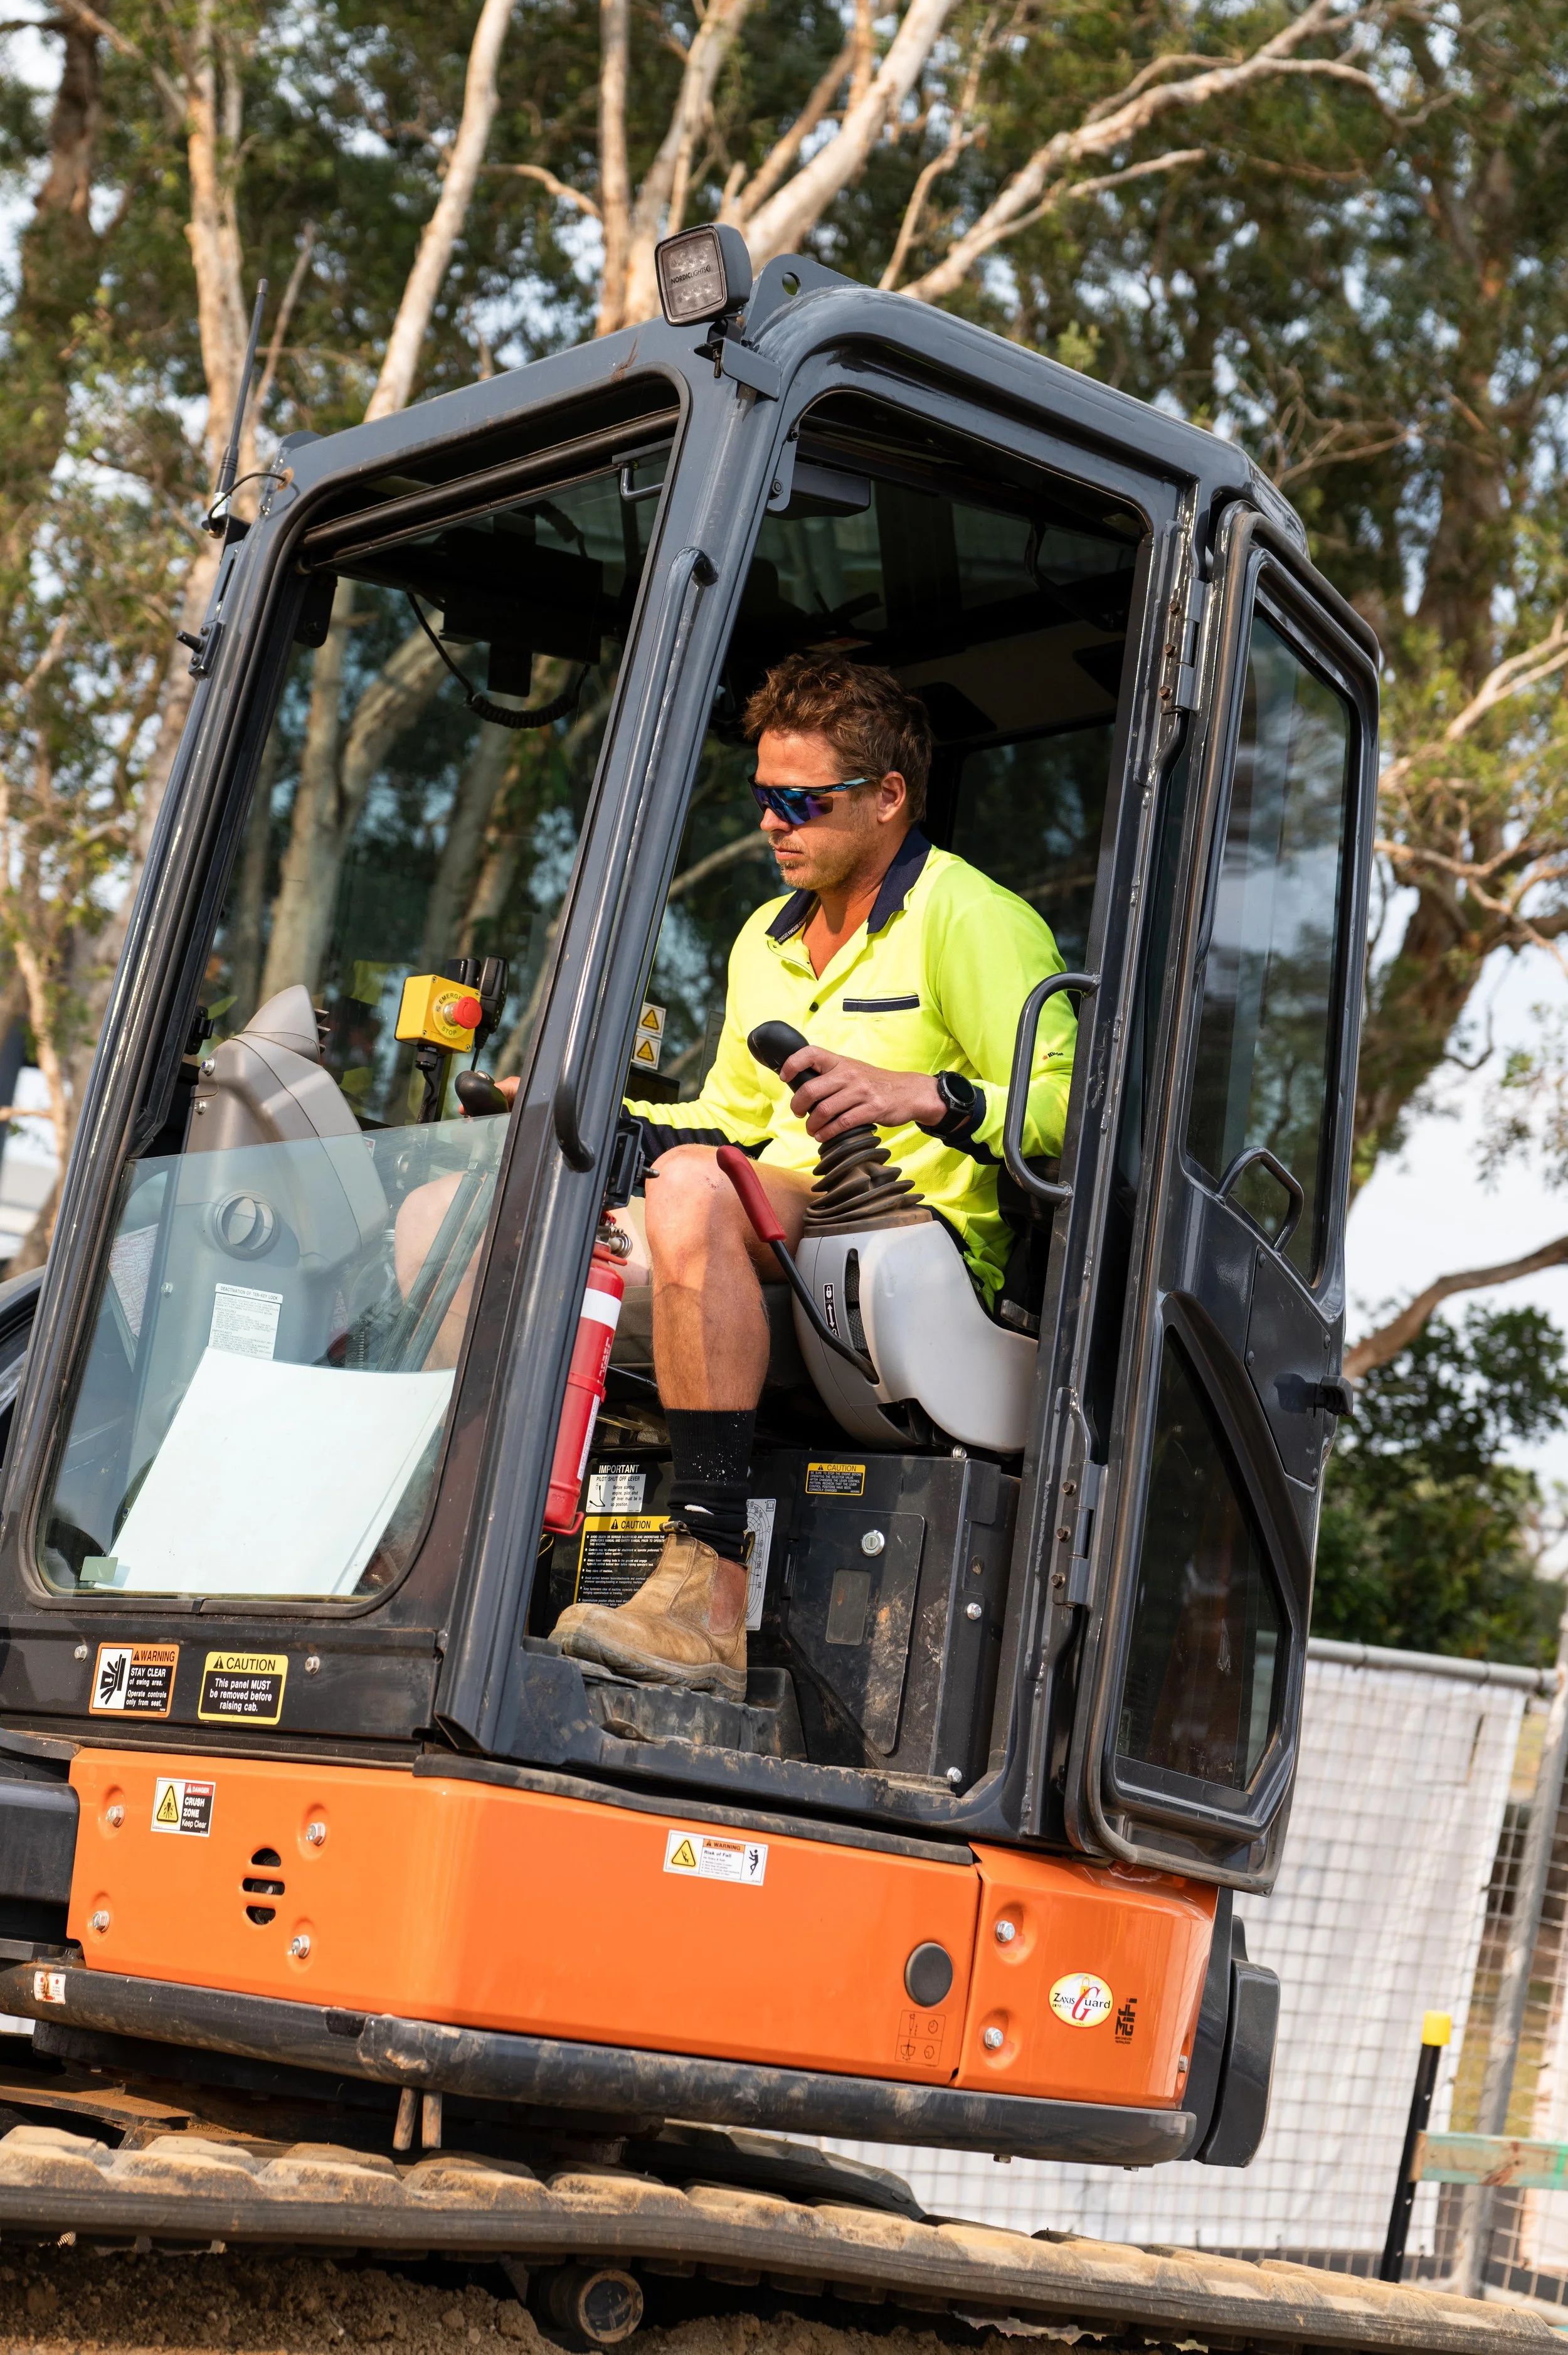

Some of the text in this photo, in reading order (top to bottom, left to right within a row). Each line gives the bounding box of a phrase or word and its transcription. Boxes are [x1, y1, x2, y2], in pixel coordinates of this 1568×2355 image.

[671, 266, 706, 284] NORDICLIGHTS
[439, 993, 462, 1004] EMERGE
[442, 1026, 457, 1036] STOP
[220, 1286, 246, 1295] DEACTIVATION
[599, 1465, 639, 1474] IMPORTANT
[621, 1521, 651, 1529] CAUTION
[141, 1651, 175, 1662] WARNING
[226, 1657, 276, 1671] CAUTION
[131, 1667, 166, 1677] STAY CLEAR
[136, 1679, 149, 1687] swing
[215, 1678, 271, 1690] This panel MUST
[128, 1690, 146, 1698] Operate
[209, 1689, 272, 1702] be removed before
[220, 1700, 258, 1712] raising cab.
[185, 1796, 205, 1807] CRUSH
[183, 1808, 200, 1818] ZONE
[182, 1818, 206, 1828] Keep Clear
[1053, 1992, 1075, 2004] ZAXIS
[1072, 1987, 1110, 2021] Guard
